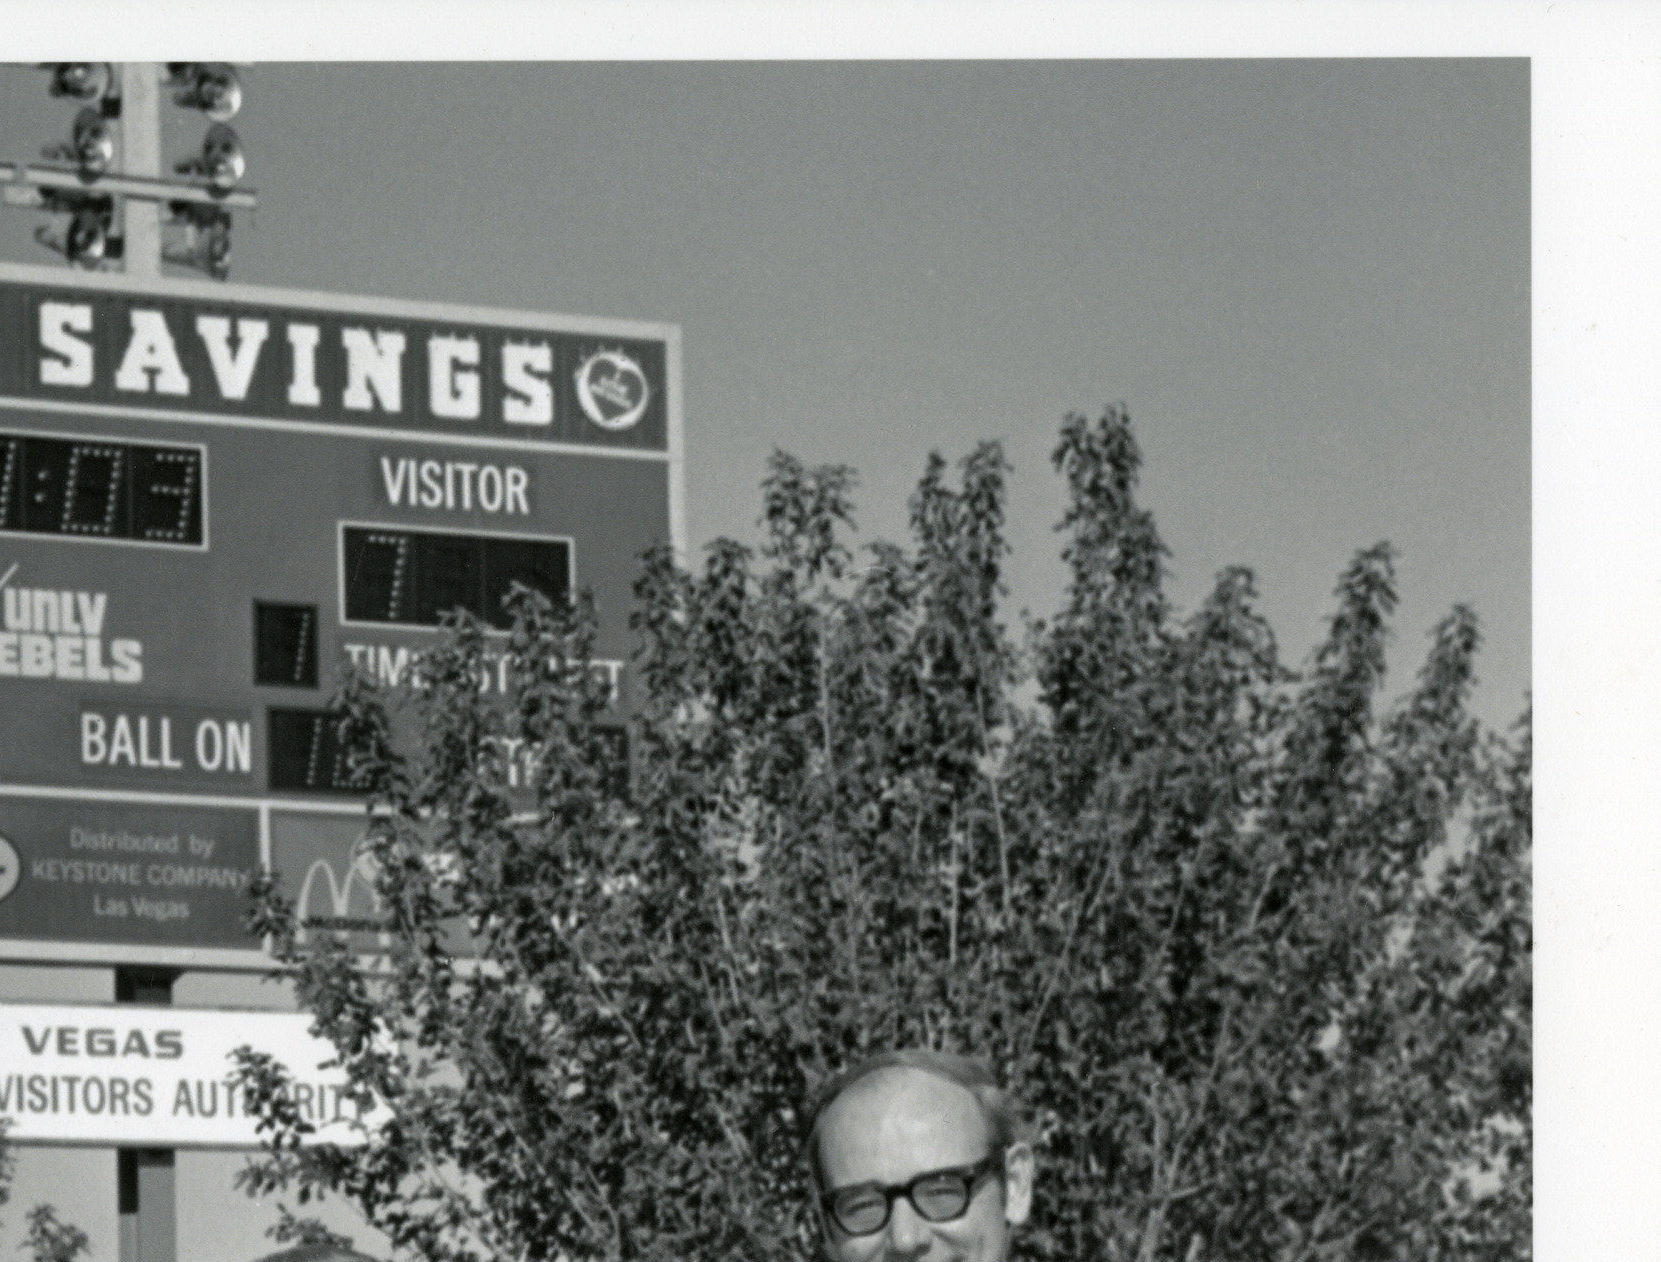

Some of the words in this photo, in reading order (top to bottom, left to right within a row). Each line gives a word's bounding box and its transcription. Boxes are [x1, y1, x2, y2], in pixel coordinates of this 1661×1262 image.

[39, 301, 554, 427] SAVINGS
[380, 456, 530, 515] VISITOR
[368, 534, 409, 621] 7
[80, 711, 182, 769] BALL
[195, 718, 252, 774] ON
[69, 826, 180, 853] Distributed
[189, 833, 216, 860] by
[32, 858, 141, 886] KEYSTONE
[146, 863, 250, 890] COMPANY
[93, 893, 128, 917] Las
[130, 896, 192, 922] Vegas
[22, 1026, 184, 1060] VEGAS
